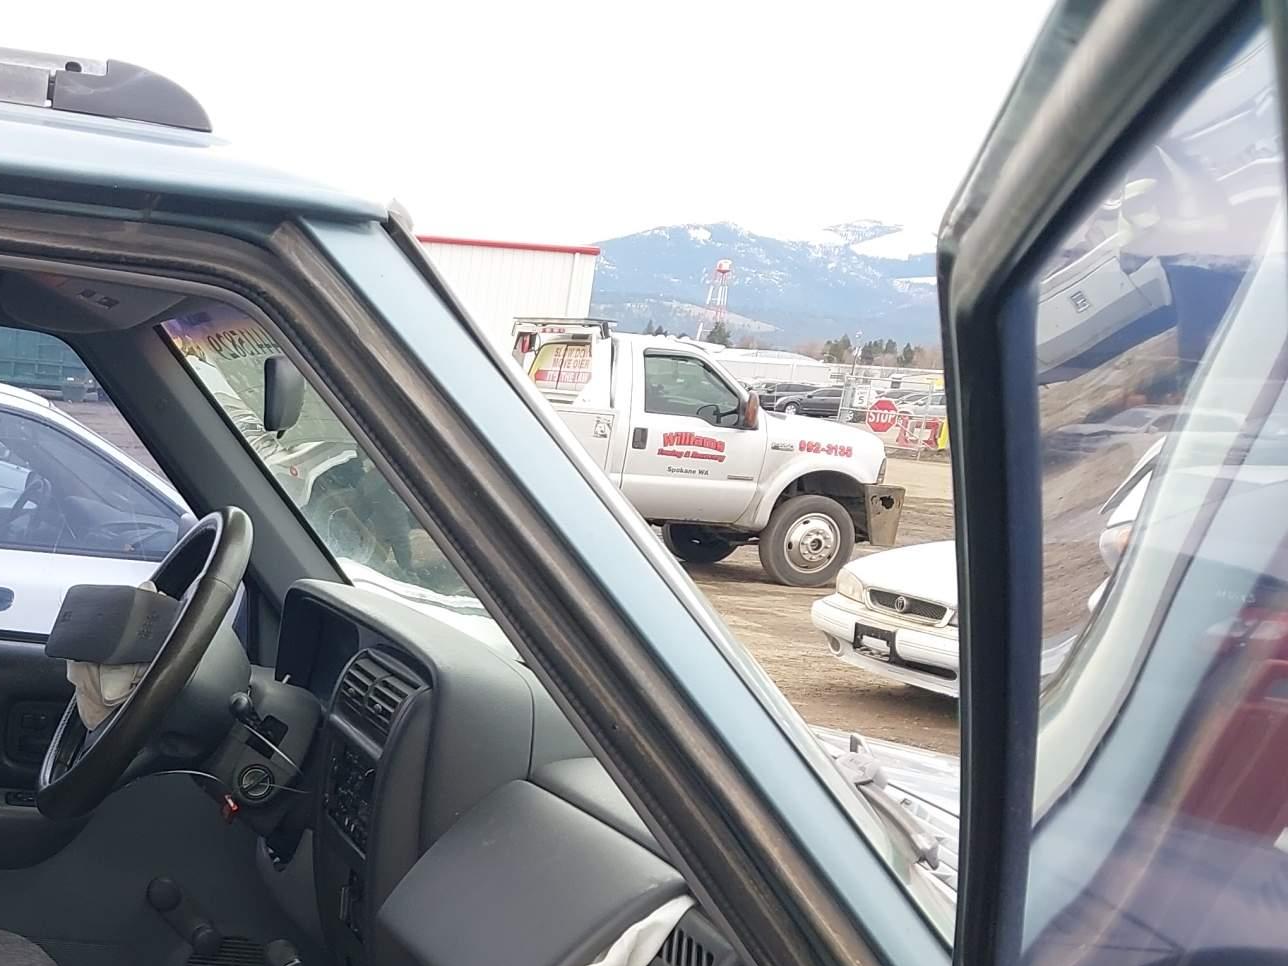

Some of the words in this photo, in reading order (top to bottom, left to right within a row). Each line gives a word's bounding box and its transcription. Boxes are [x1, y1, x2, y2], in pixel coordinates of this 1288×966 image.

[869, 410, 895, 424] STOP
[663, 432, 726, 453] Williams
[667, 466, 697, 475] Spokane
[698, 468, 710, 476] WA
